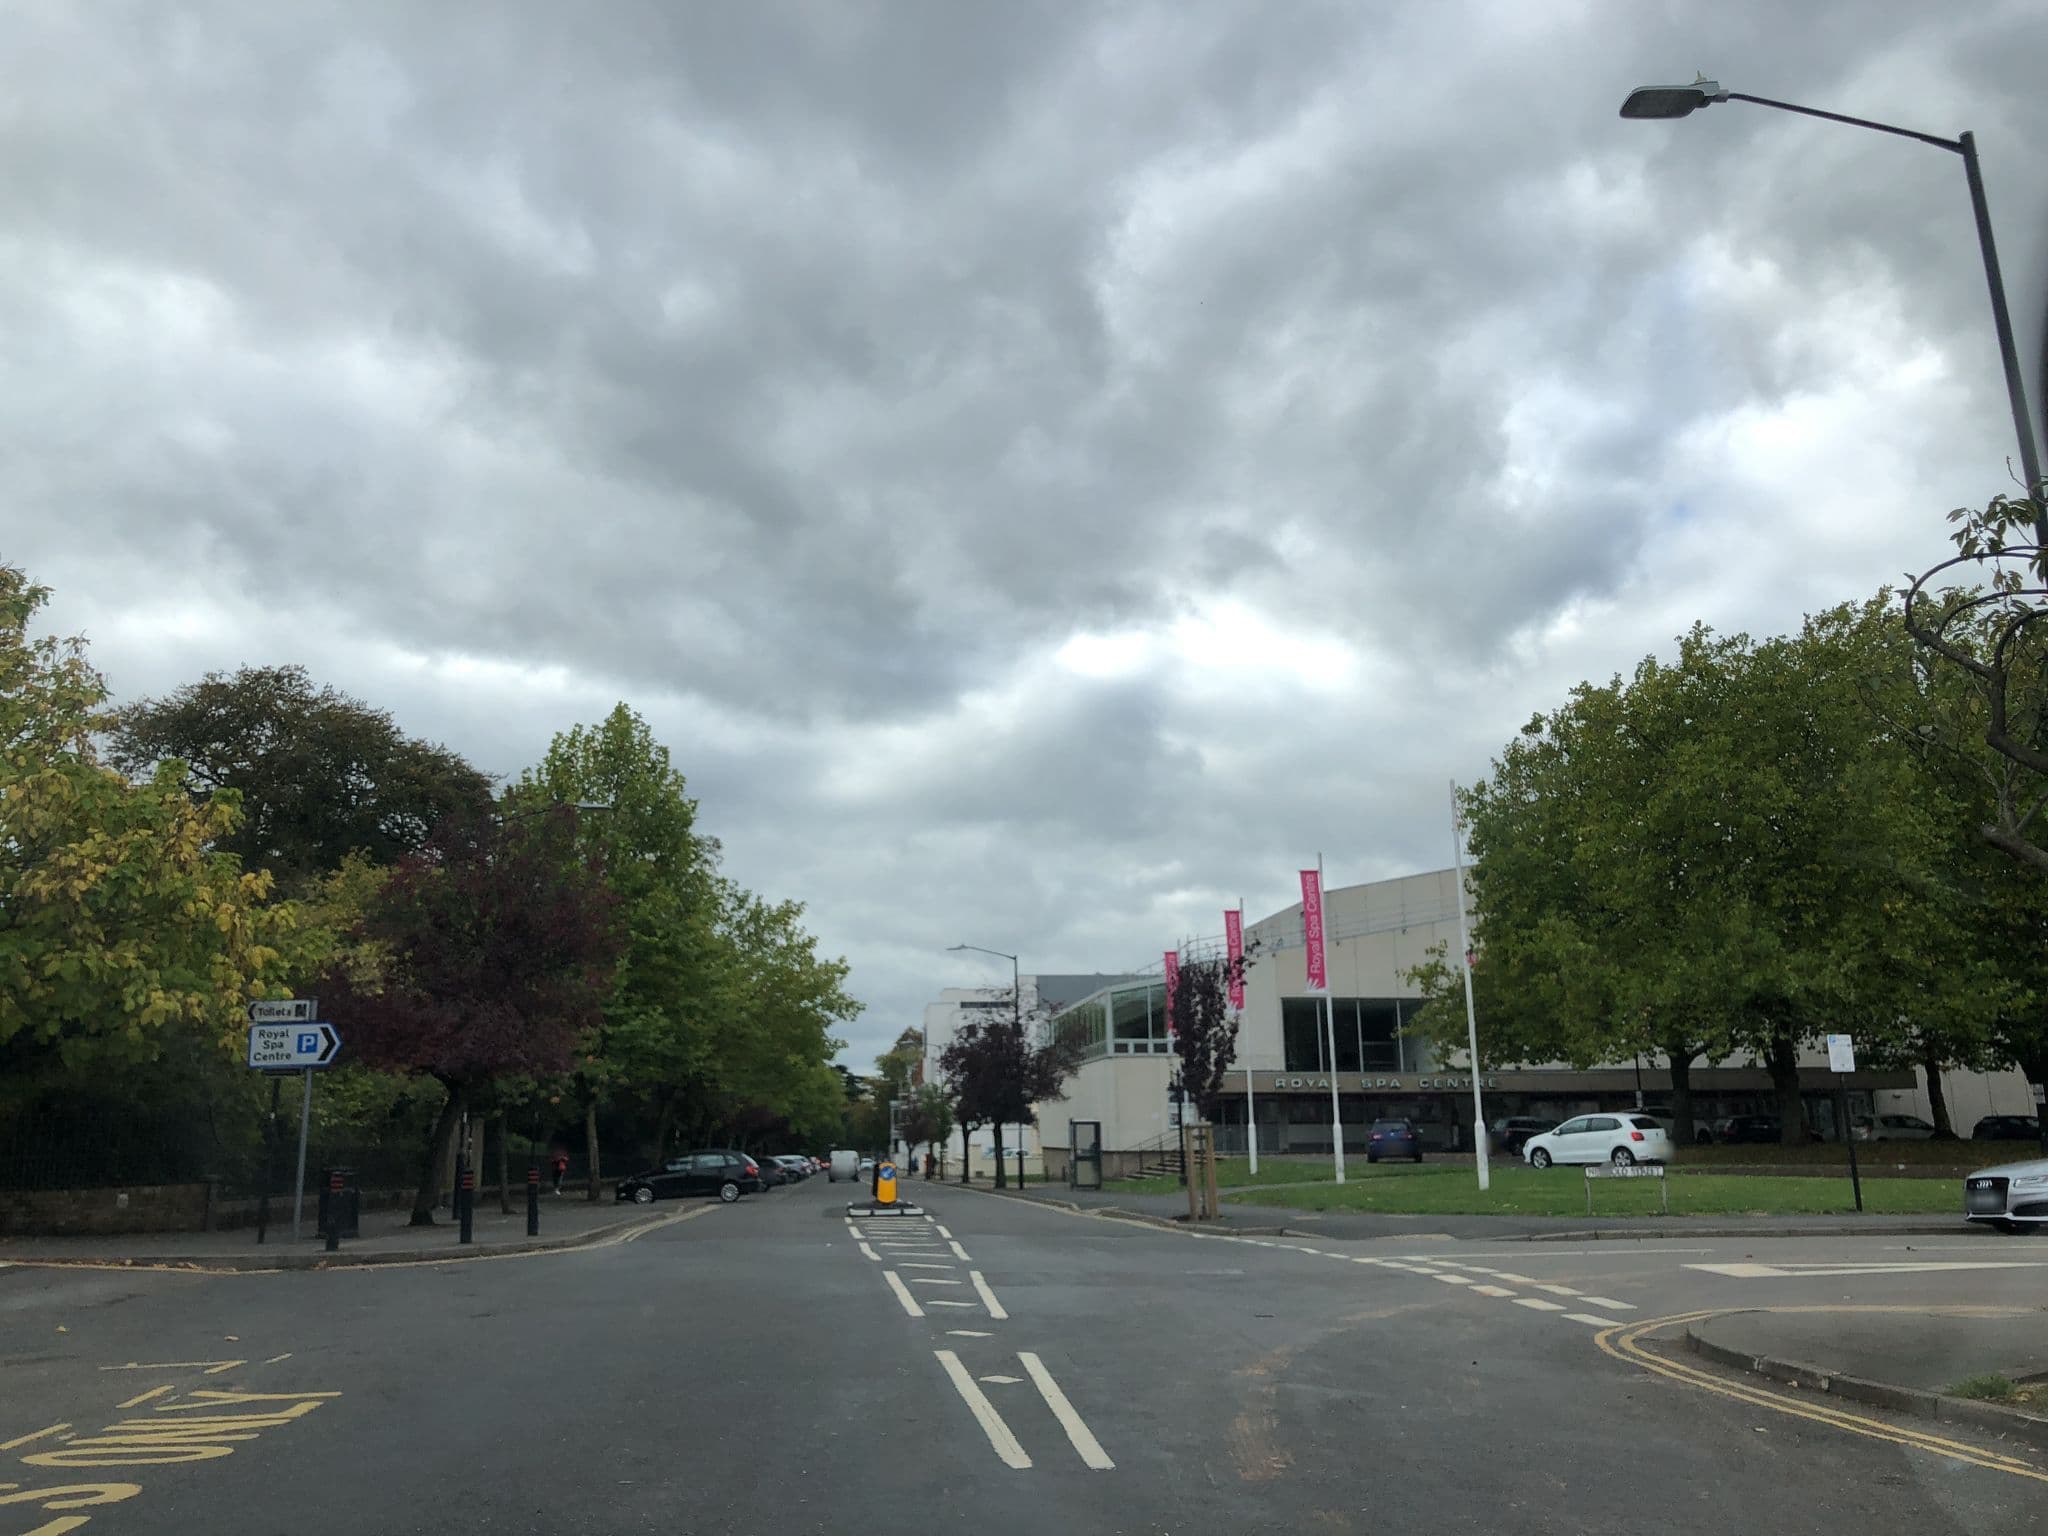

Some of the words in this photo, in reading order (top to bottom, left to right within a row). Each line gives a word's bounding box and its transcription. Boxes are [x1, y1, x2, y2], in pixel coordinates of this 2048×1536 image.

[1306, 875, 1316, 912] Centre
[1309, 915, 1319, 939] Spa
[1311, 941, 1321, 974] Royal
[258, 1007, 292, 1017] Toilets
[258, 1029, 289, 1040] Royal
[262, 1039, 284, 1050] Spa
[301, 1035, 316, 1052] P
[253, 1052, 292, 1061] Centre
[1275, 1078, 1341, 1089] ROYA
[1361, 1078, 1401, 1089] SPA
